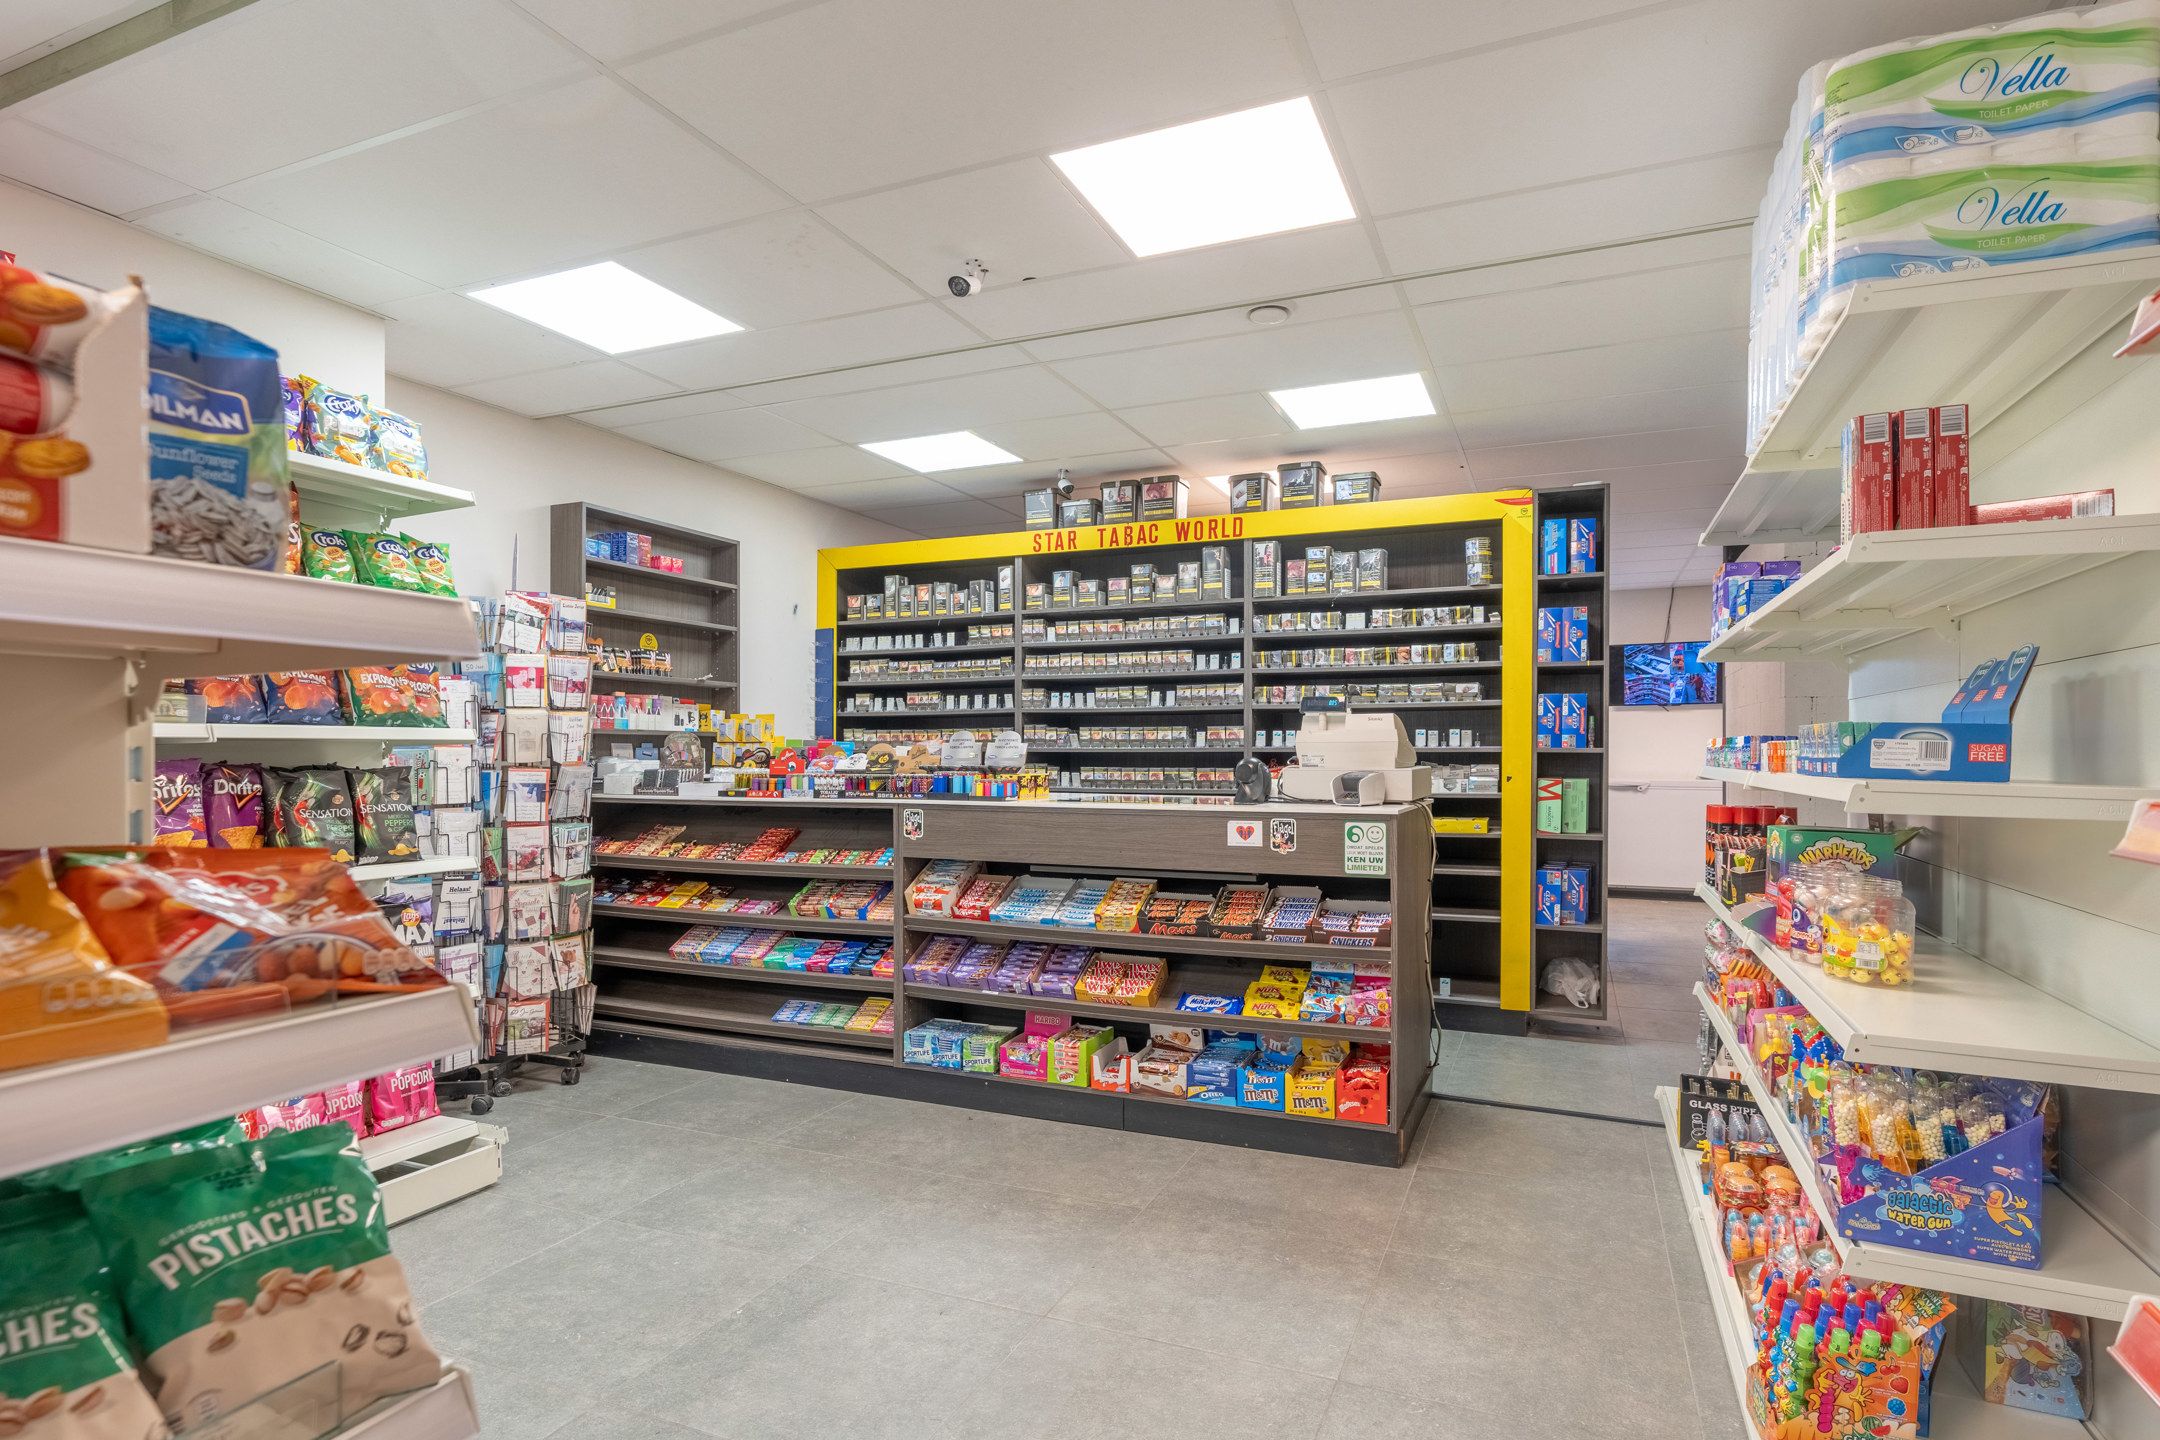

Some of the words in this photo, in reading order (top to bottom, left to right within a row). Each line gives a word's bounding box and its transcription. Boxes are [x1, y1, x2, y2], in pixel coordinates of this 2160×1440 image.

[1959, 41, 2070, 102] Vella
[1978, 106, 2011, 120] TOILET
[2014, 99, 2050, 115] PAPER
[1956, 177, 2068, 232] Vella
[1976, 236, 2010, 249] TOILET
[2013, 232, 2047, 245] PAPER
[146, 388, 243, 432] ILMAN
[1033, 530, 1078, 553] STAR
[1097, 523, 1160, 548] TABAC
[1175, 516, 1244, 543] WORLD
[1970, 744, 2004, 752] SUGAR
[1970, 752, 2004, 762] FREE
[300, 807, 353, 819] SENSATION
[361, 803, 414, 815] SENSATION
[1347, 856, 1366, 864] KEN
[1797, 843, 1878, 870] WARHEADS
[1347, 864, 1384, 872] LIMIETEN
[1148, 922, 1198, 936] Mars
[1220, 931, 1253, 940] Mars
[1273, 935, 1305, 943] SNICKERS
[1329, 937, 1374, 947] SNICKERS
[1034, 1015, 1061, 1025] HARIBO
[932, 1053, 959, 1061] SPORTLIFE
[964, 1058, 992, 1066] SPORTLIFE
[1200, 1091, 1225, 1099] OREO
[1689, 1099, 1728, 1112] GLASS
[1887, 1191, 1954, 1216] galactic
[147, 1193, 359, 1291] PISTACHES
